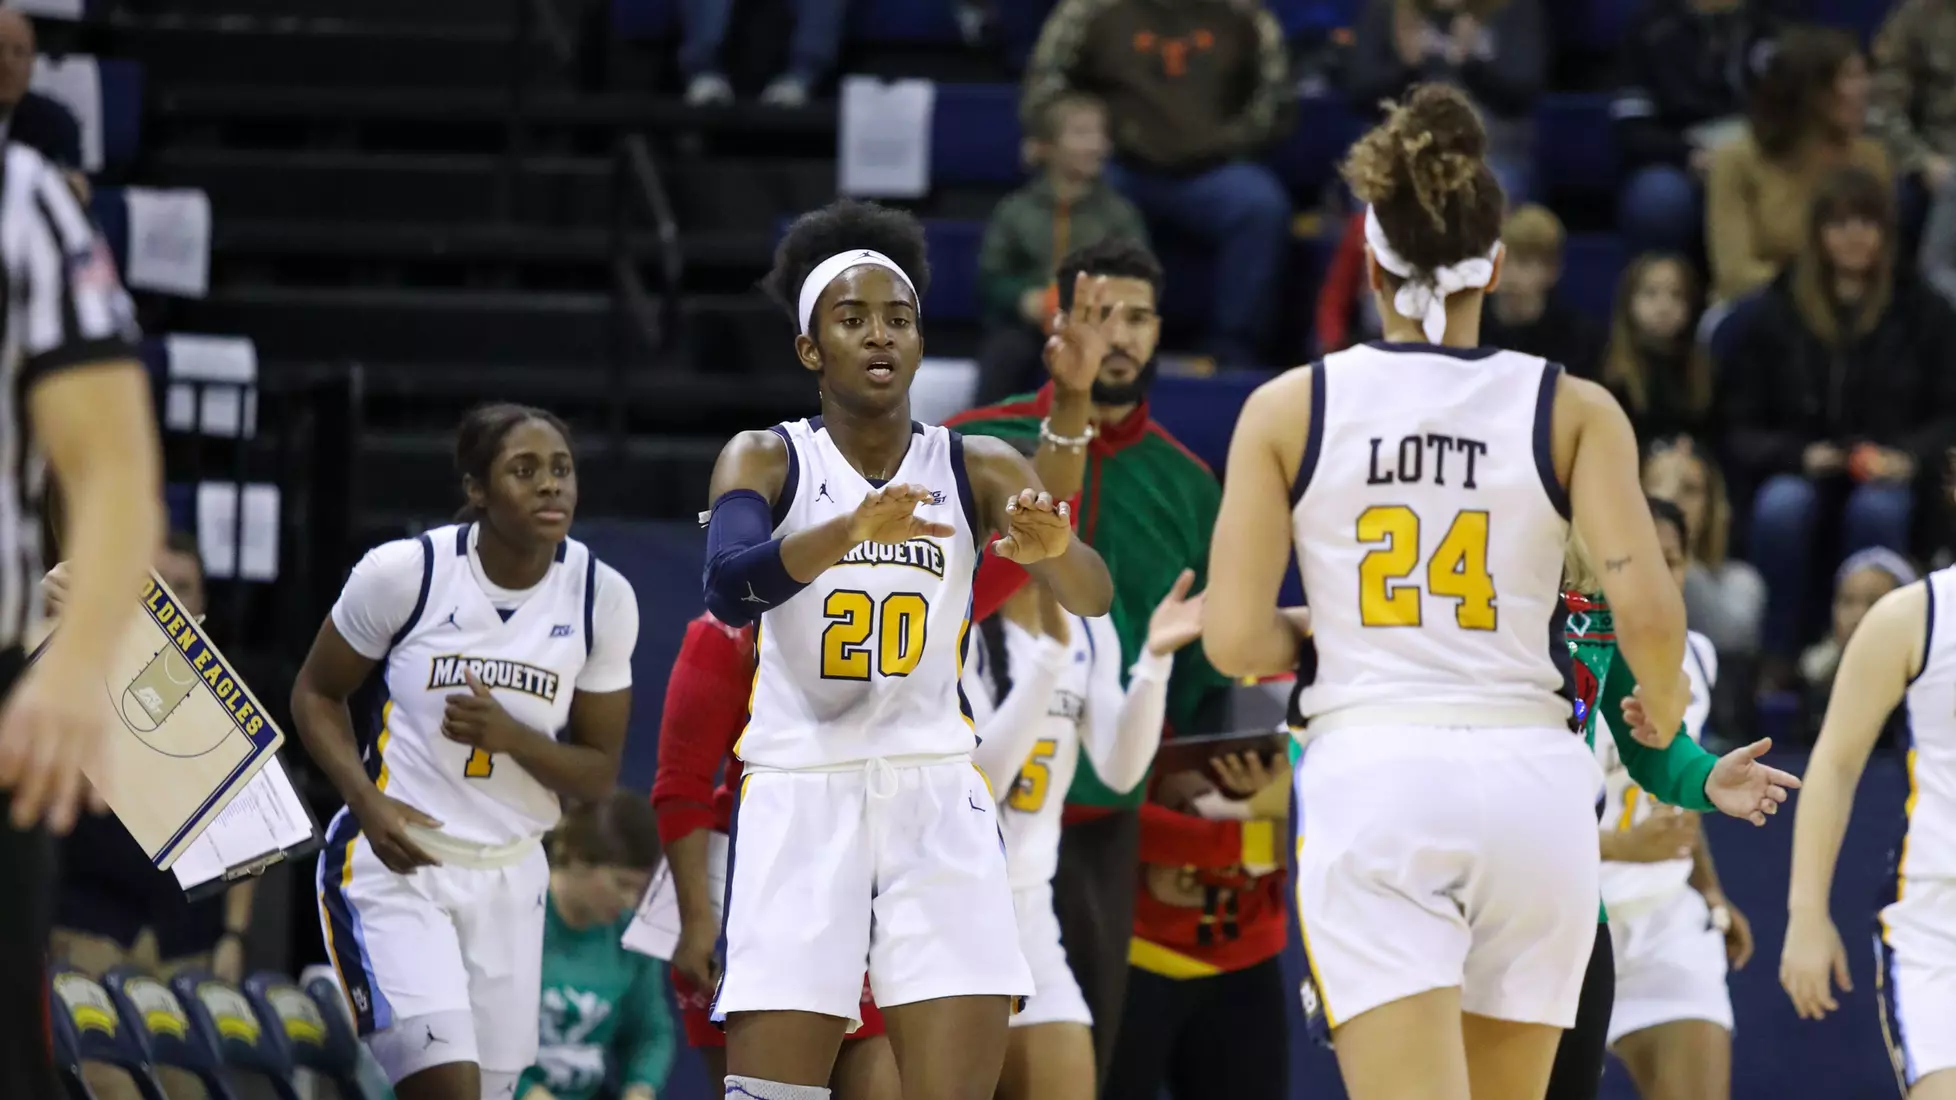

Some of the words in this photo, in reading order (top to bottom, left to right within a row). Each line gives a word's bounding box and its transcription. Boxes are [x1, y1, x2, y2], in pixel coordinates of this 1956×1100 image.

[1366, 432, 1488, 490] LOTT
[838, 538, 945, 579] RQUETTE
[1355, 504, 1498, 632] 24
[140, 577, 198, 652] OLDEN
[193, 647, 264, 736] EAGLES
[820, 588, 930, 682] 20
[428, 654, 559, 704] MARQUETTE
